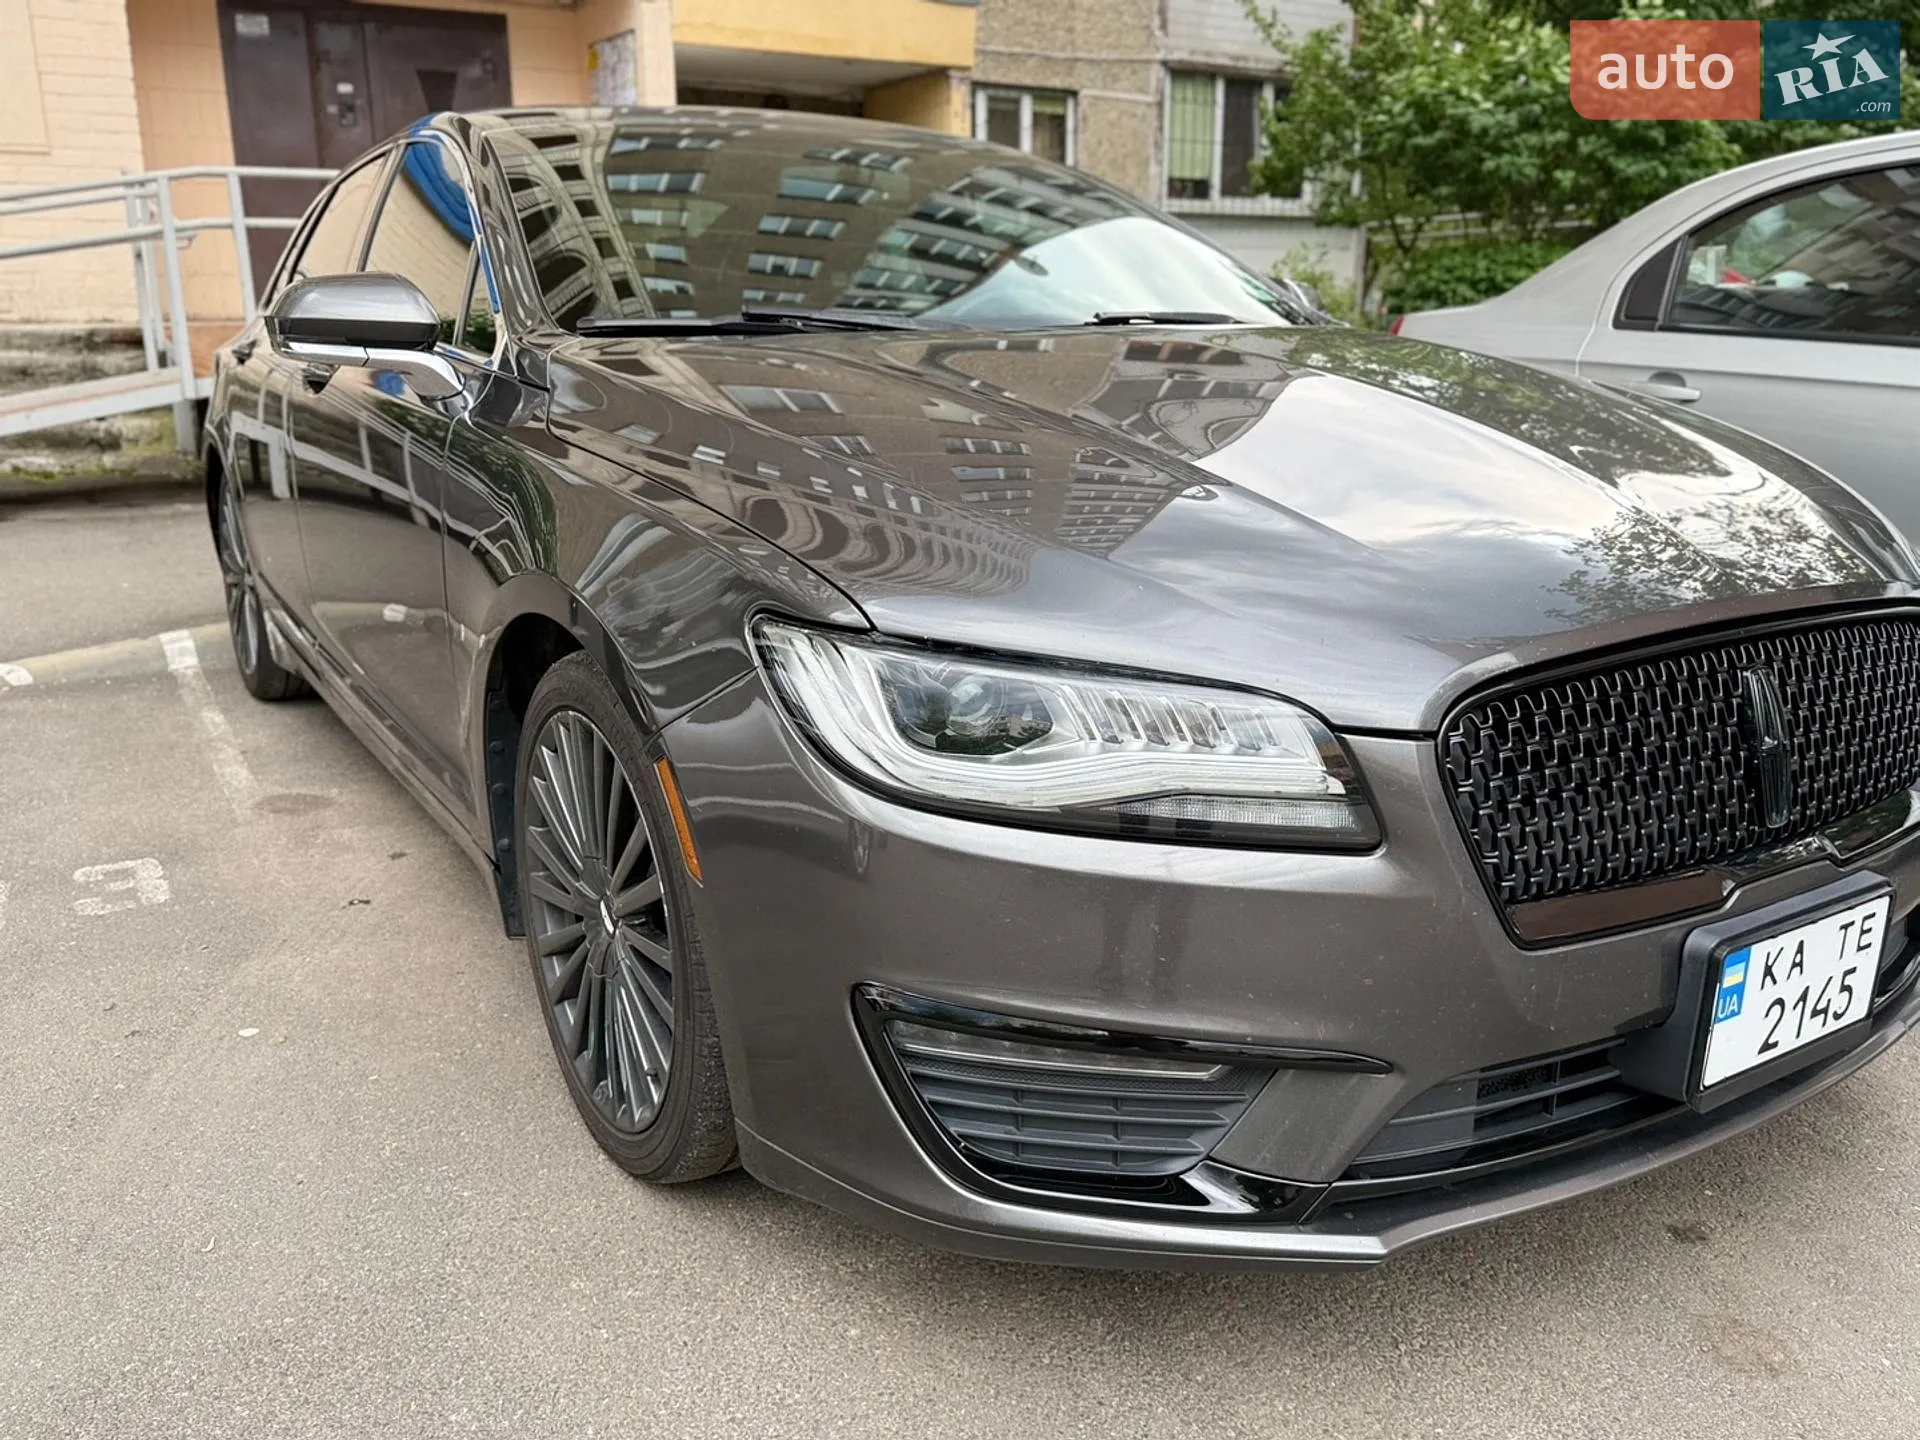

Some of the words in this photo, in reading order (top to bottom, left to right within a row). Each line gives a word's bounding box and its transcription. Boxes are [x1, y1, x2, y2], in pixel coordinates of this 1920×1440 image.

[1760, 939, 1805, 991] KA
[1838, 911, 1877, 961] TE
[1717, 993, 1739, 1019] UA
[1757, 966, 1858, 1056] 2145
